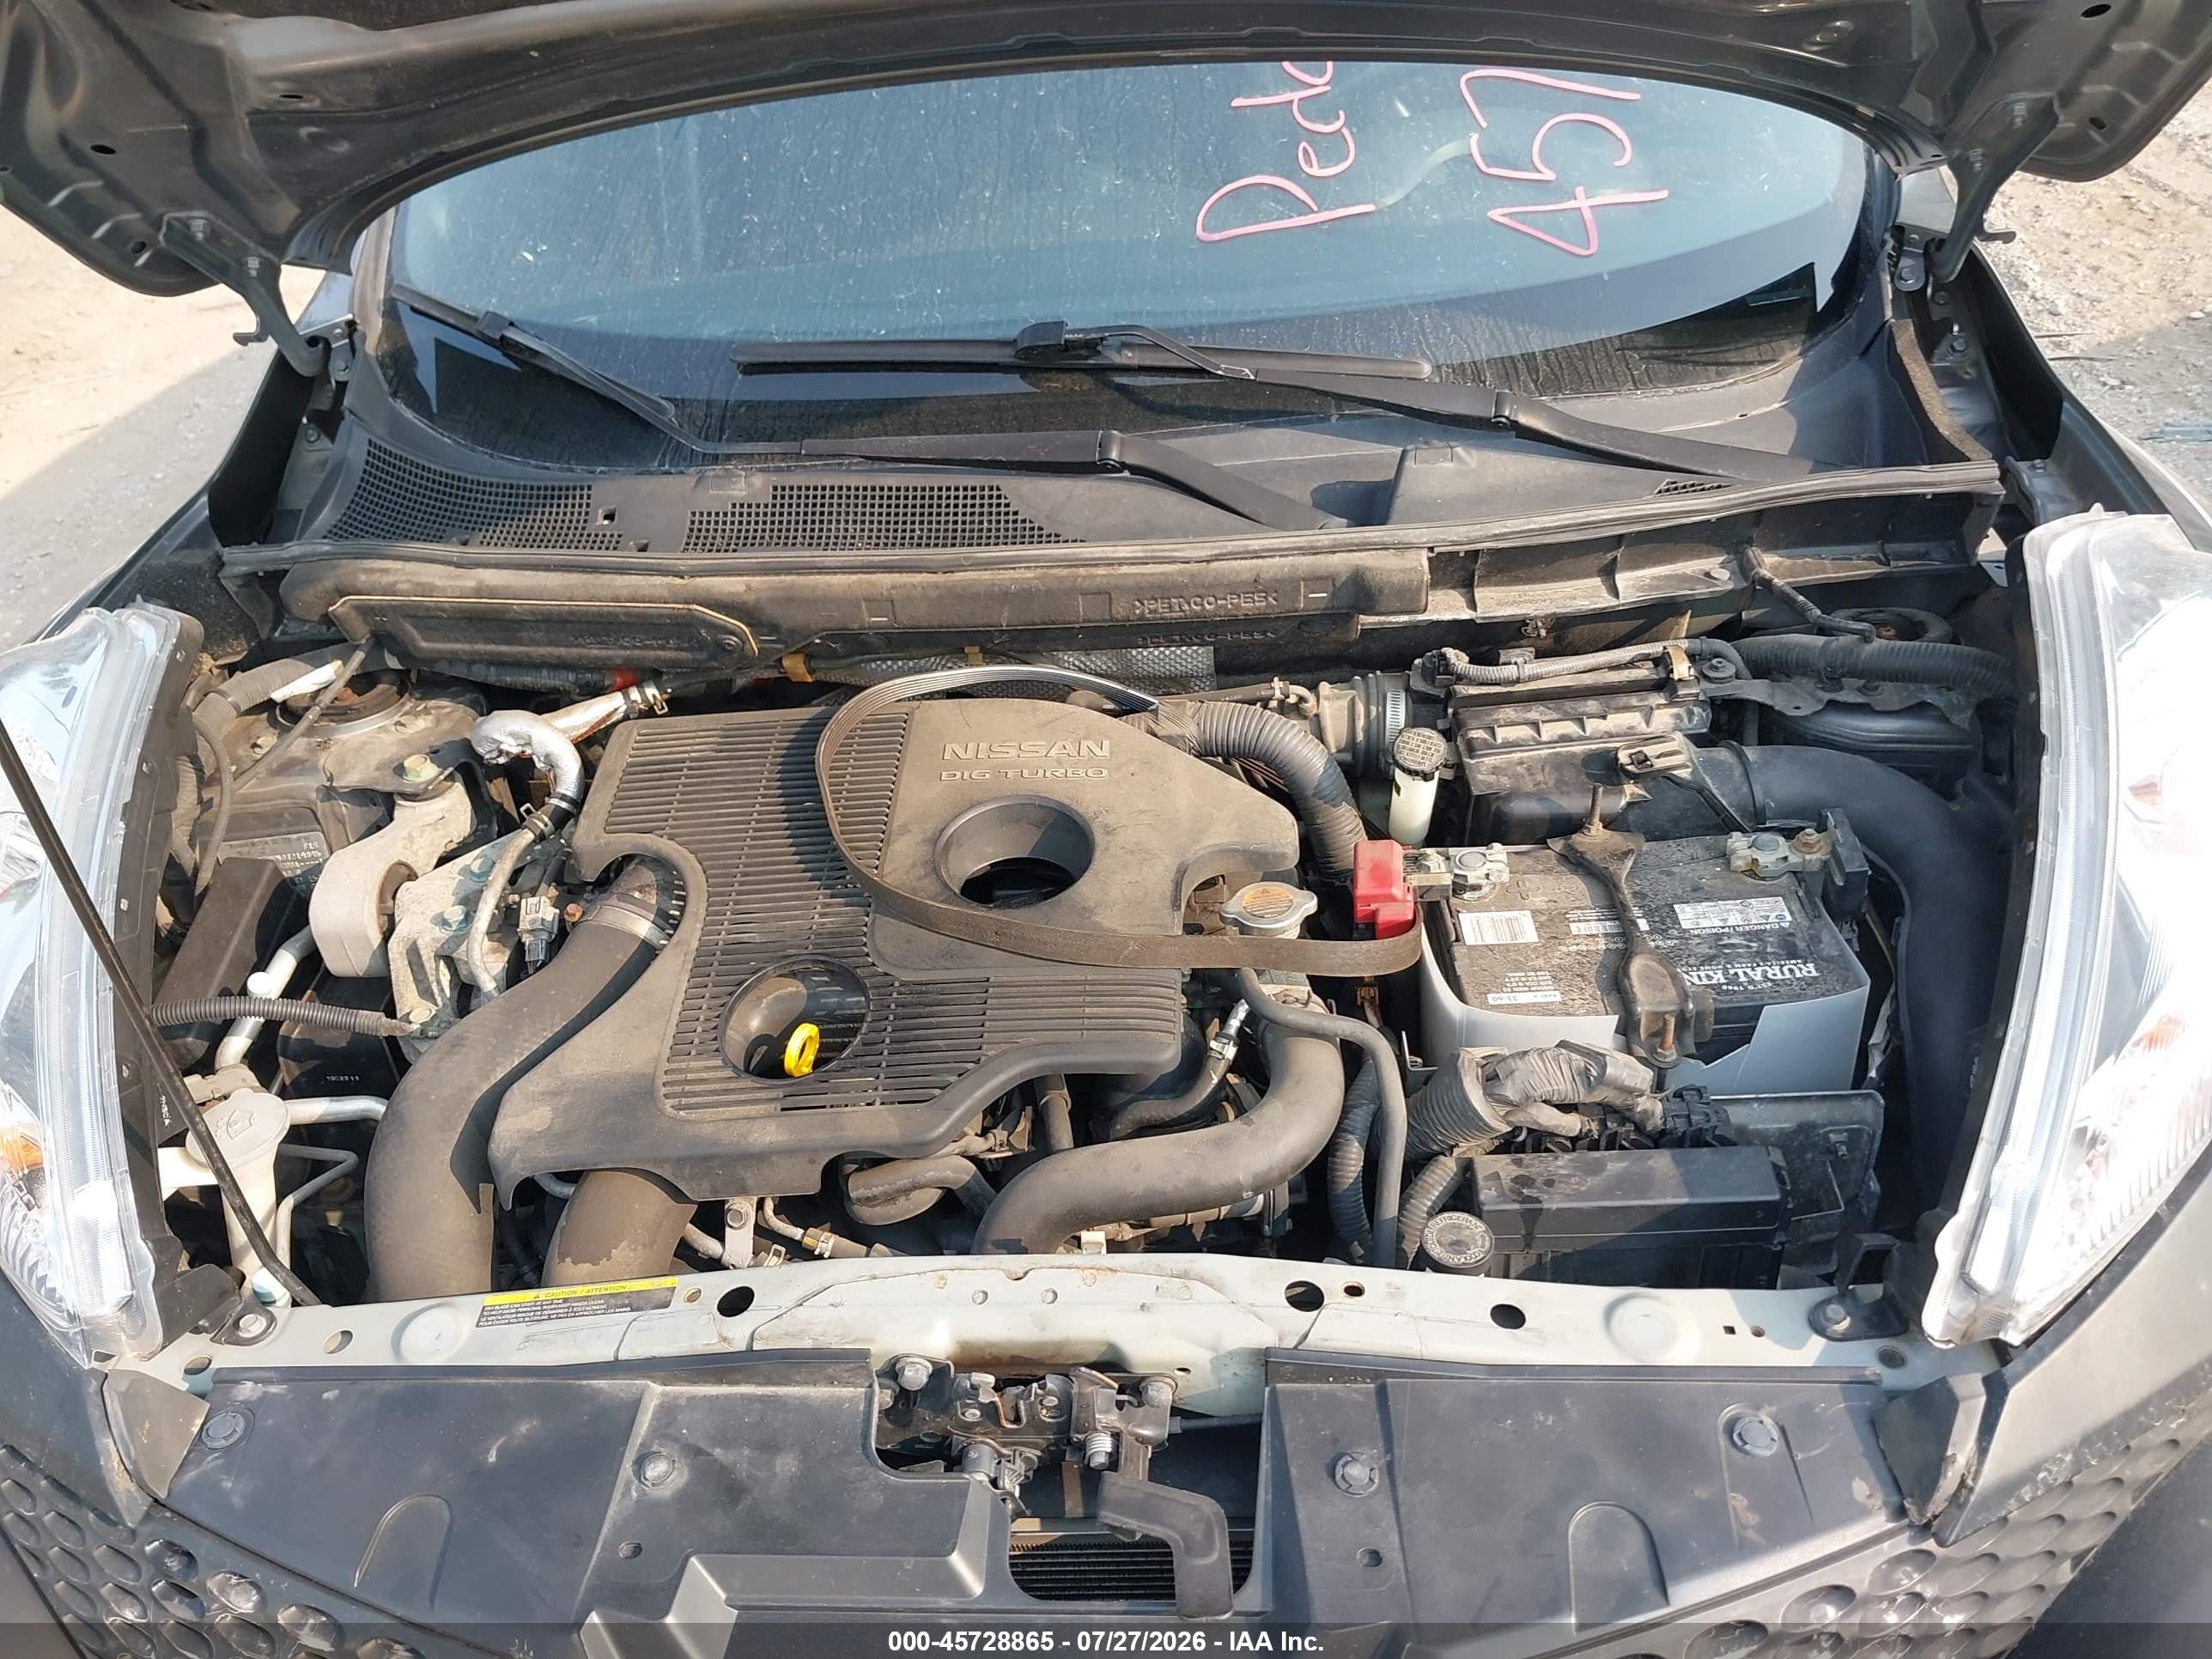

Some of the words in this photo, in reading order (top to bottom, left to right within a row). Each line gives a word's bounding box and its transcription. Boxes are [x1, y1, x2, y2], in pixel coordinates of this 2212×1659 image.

[1460, 68, 1669, 257] 457
[942, 739, 1110, 761] NISSAN
[939, 769, 990, 781] DIG
[999, 767, 1109, 781] TURBO
[1729, 963, 1820, 982] RURAL
[545, 1290, 578, 1298] CAUTION
[586, 1285, 627, 1294] ATTENTION
